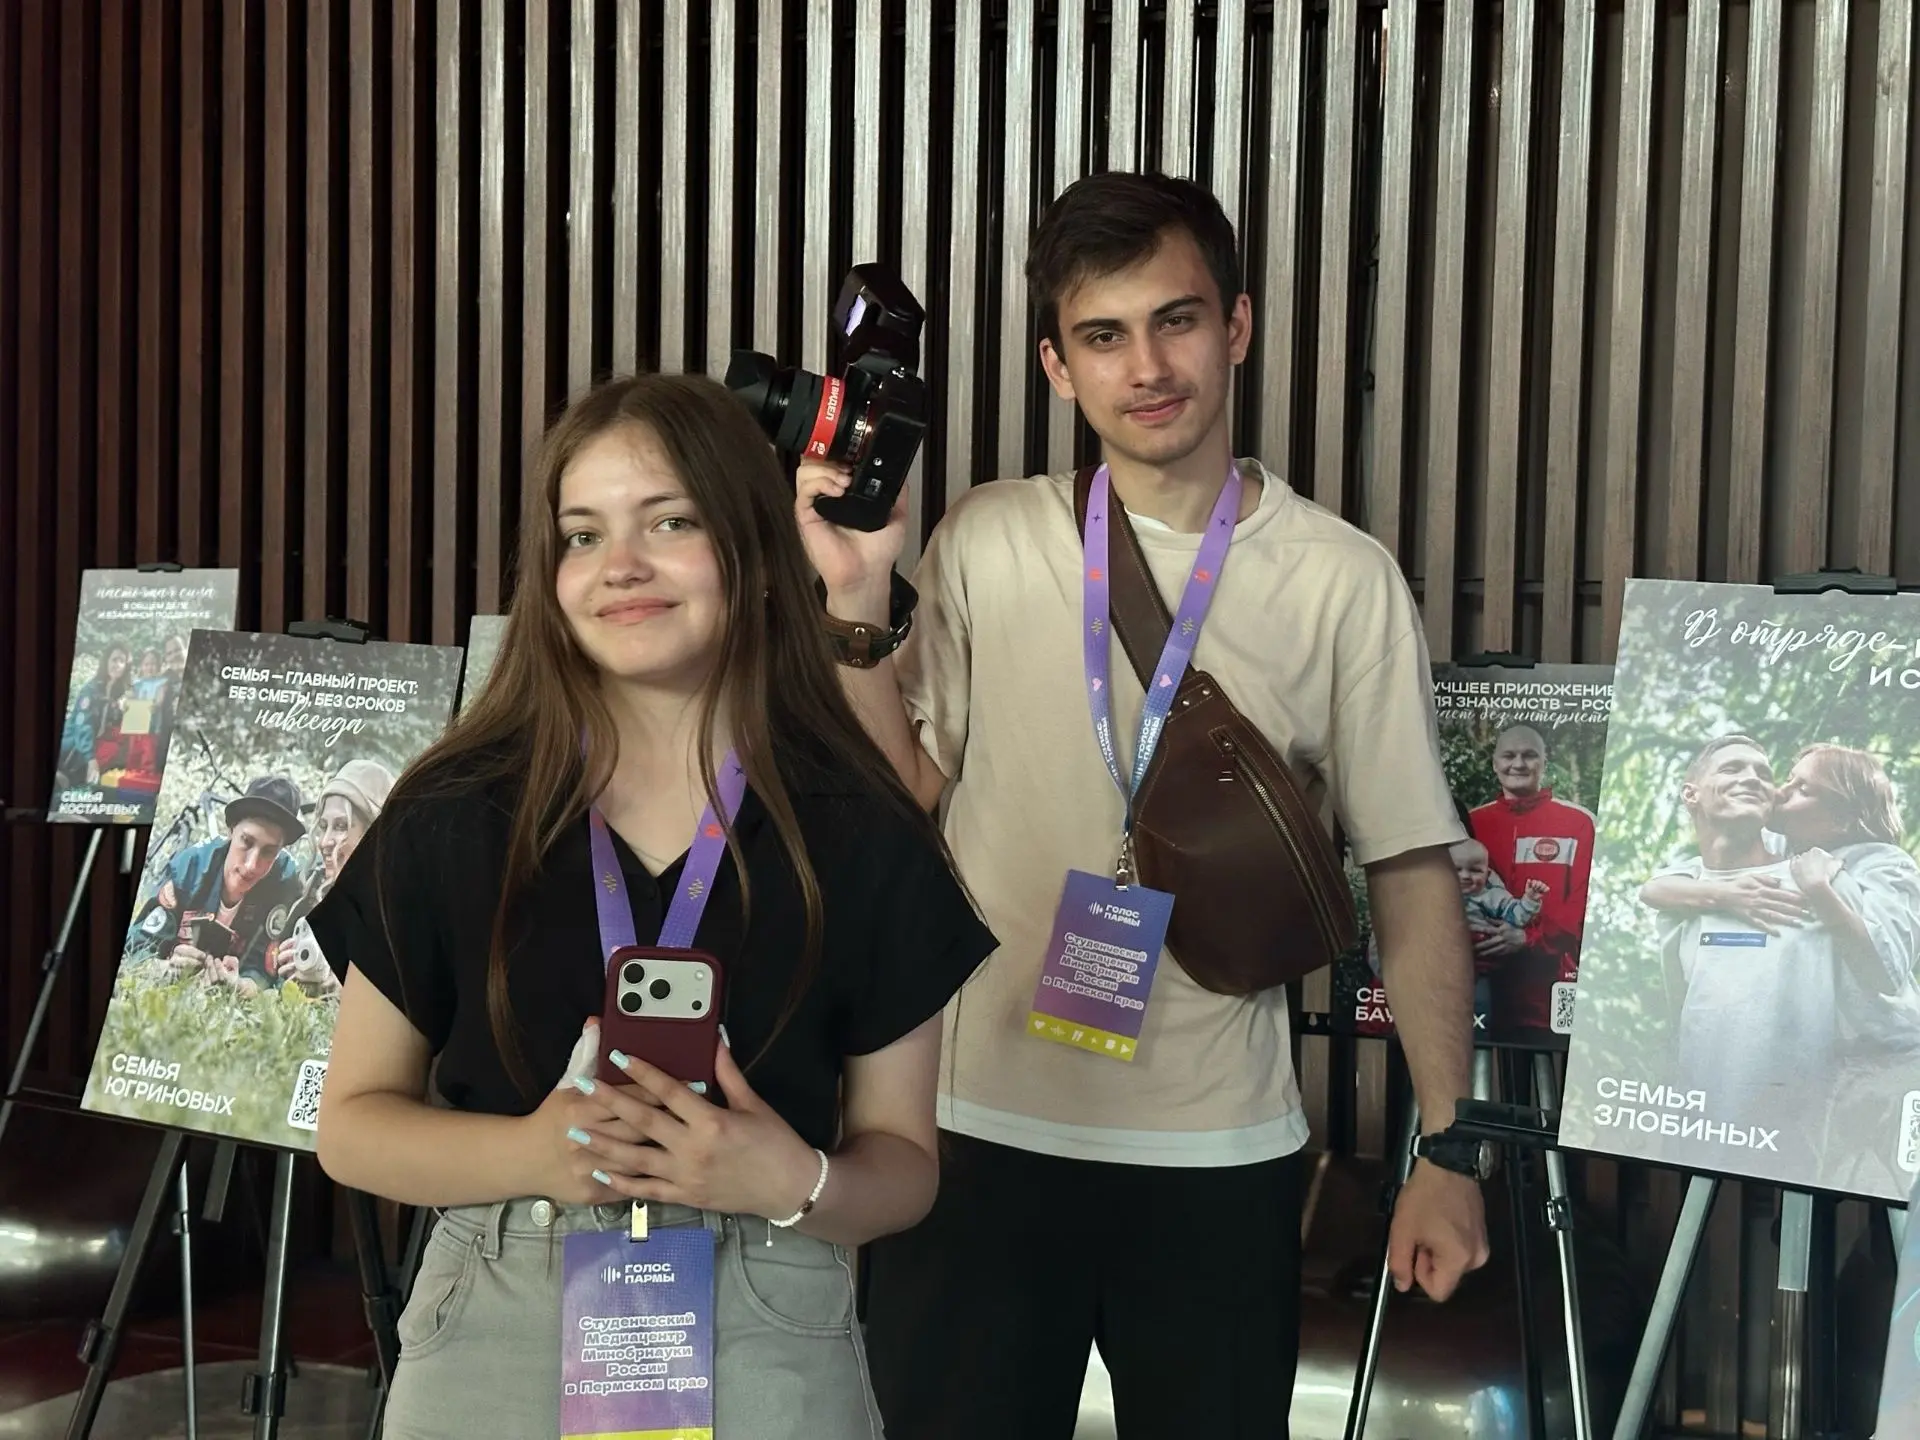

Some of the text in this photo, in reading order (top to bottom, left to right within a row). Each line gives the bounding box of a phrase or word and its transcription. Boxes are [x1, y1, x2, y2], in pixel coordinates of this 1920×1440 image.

[1683, 607, 1722, 648] В
[1730, 619, 1897, 672] отряде
[221, 665, 270, 682] СЕМЬЯ
[285, 671, 355, 690] ГЛАВНЫЙ
[357, 677, 419, 695] ПРОЕКТ:
[1432, 681, 1615, 697] УЧШЕЕ ПРИЛОЖЕНИЕ
[228, 685, 406, 713] БЕЗ СМЕТЫ, БЕЗ СРОКОВ
[1434, 695, 1452, 708] ЛЯ
[1456, 696, 1561, 710] ЗНАКОМСТВ
[254, 697, 366, 748] навсегда
[1103, 912, 1141, 927] ПАРМЫ
[1105, 904, 1140, 919] ГОЛОС
[1064, 931, 1147, 962] Студенческий
[1059, 955, 1139, 985] Минобрнауки
[1065, 945, 1137, 973] Медиацентр
[1042, 975, 1144, 1010] в Пермском крае
[1074, 970, 1119, 991] России
[111, 1053, 181, 1082] СЕМЬЯ
[104, 1075, 236, 1116] ЮГРИНОВЫХ
[1596, 1076, 1707, 1112] СЕМЬЯ
[1593, 1103, 1780, 1152] ЗЛОБИНЫХ
[624, 1263, 671, 1273] ГОЛОС
[624, 1272, 675, 1284] ПАРМЫ
[579, 1312, 695, 1330] Студенческий
[584, 1330, 687, 1346] Медиацентр
[581, 1345, 693, 1362] Минобрнауки
[606, 1362, 668, 1377] России
[565, 1376, 708, 1395] в Пермском крае
